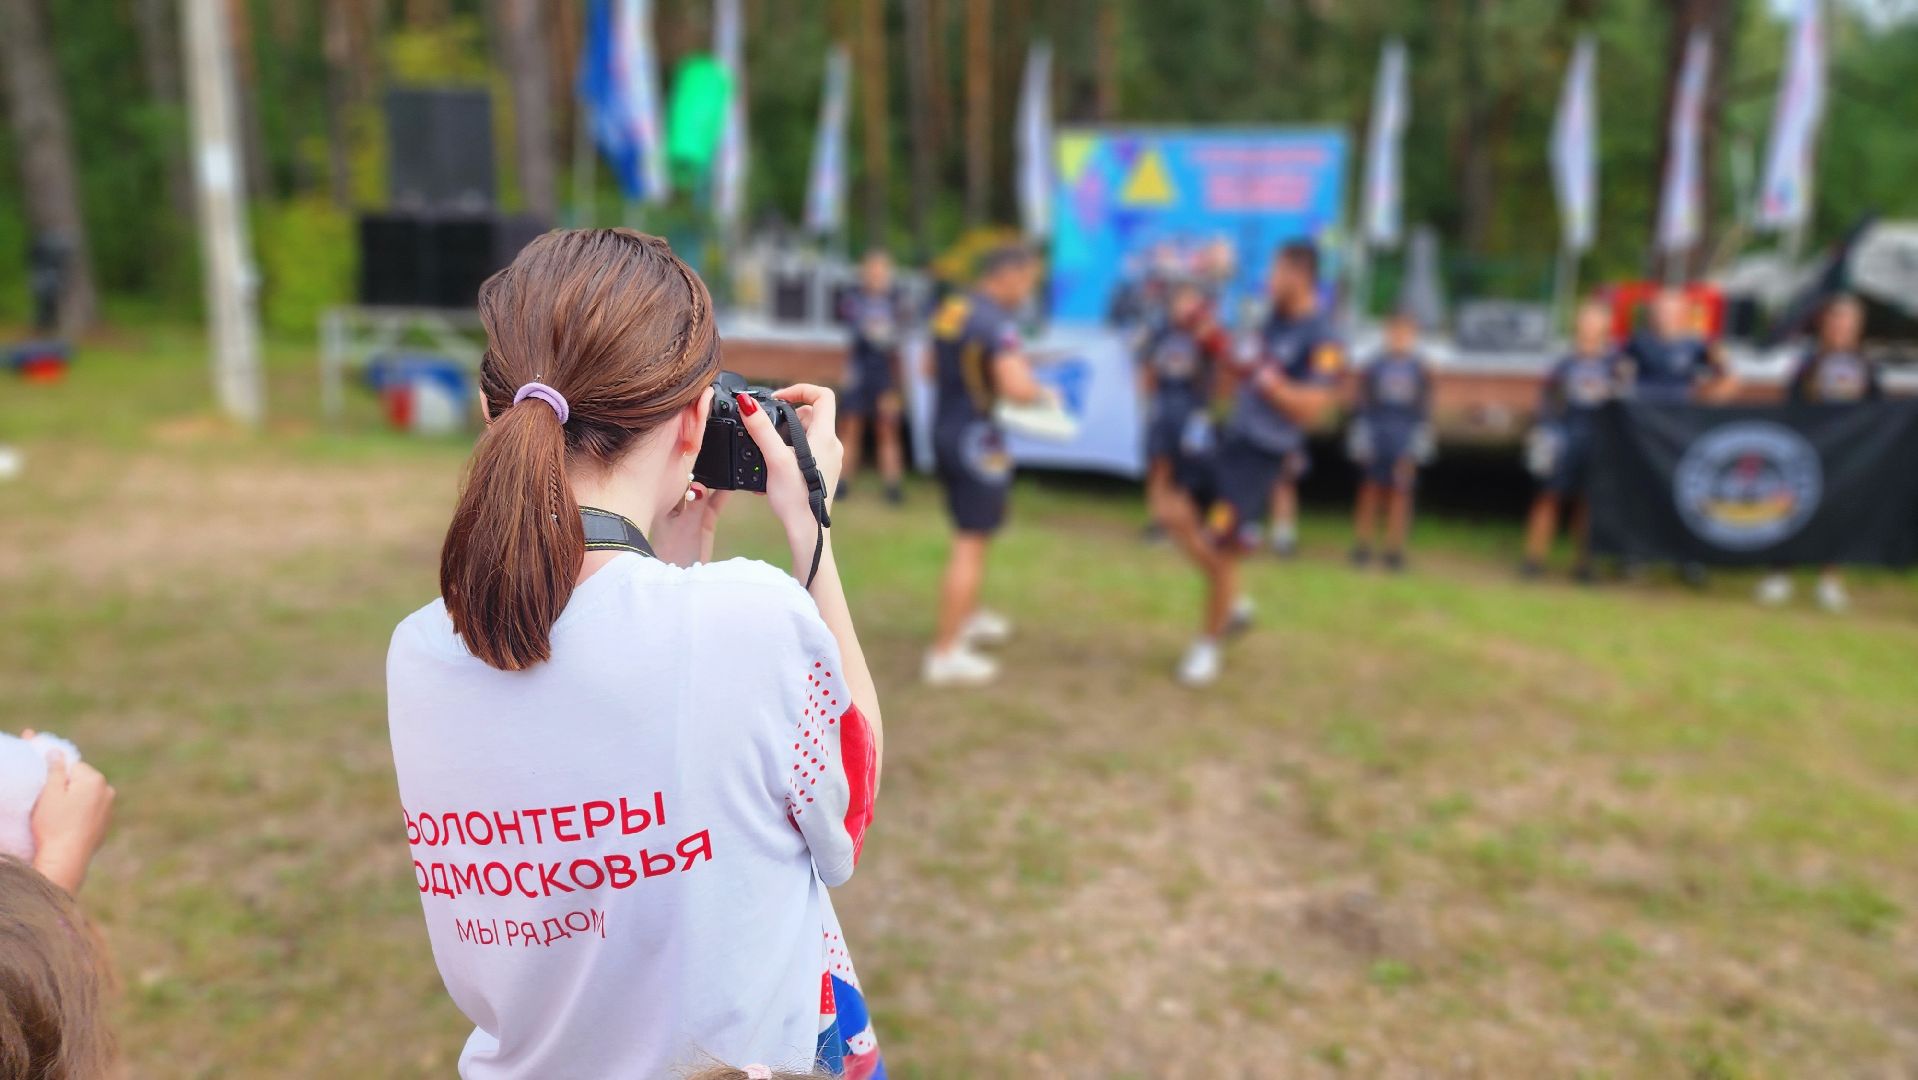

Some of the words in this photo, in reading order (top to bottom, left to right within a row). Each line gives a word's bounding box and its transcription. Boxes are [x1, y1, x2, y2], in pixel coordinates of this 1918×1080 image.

[414, 829, 713, 899] ОДМОСКОВЬЯ
[456, 918, 500, 945] МЫ
[505, 908, 605, 947] РЯДОМ
